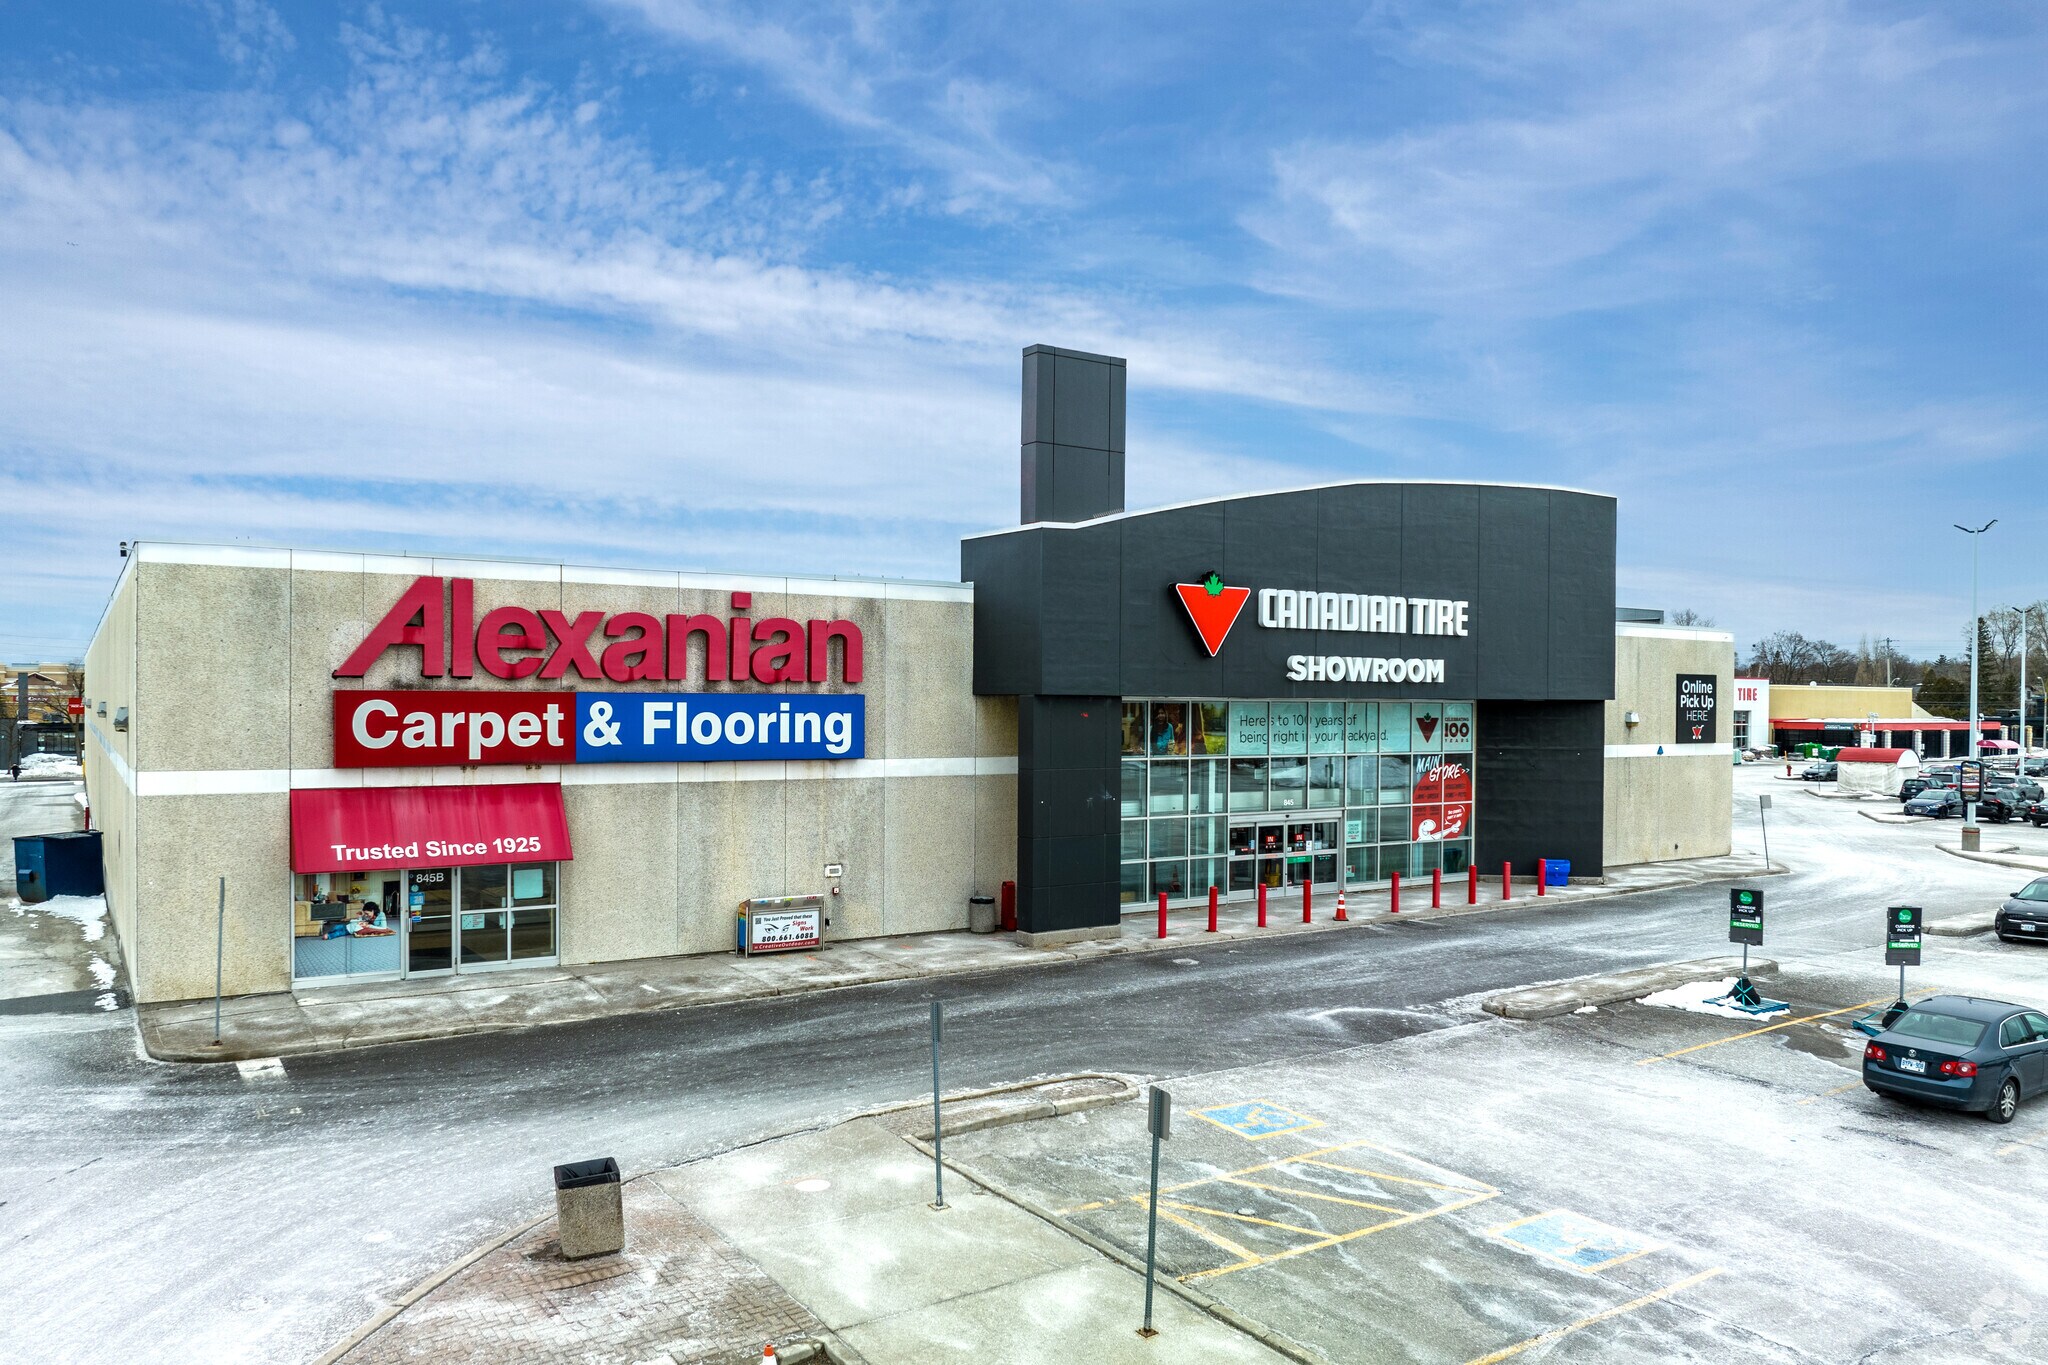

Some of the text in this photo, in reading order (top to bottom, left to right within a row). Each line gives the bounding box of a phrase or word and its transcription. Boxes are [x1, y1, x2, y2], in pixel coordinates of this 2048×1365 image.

[1258, 588, 1469, 637] CANADIAN TIRE
[332, 577, 863, 683] Alexanian
[1286, 655, 1445, 683] SHOWROOM
[1682, 680, 1713, 694] Online
[1738, 688, 1758, 701] TIRE
[1680, 695, 1714, 710] Pick Up
[1278, 715, 1289, 726] to
[1315, 716, 1343, 728] years
[1686, 710, 1708, 721] HERE
[352, 699, 852, 760] Carpet & Flooring
[1273, 730, 1298, 744] right
[1315, 732, 1338, 744] your
[1444, 722, 1470, 738] 100
[1416, 755, 1441, 774] MAIN
[1429, 763, 1462, 782] STORE
[331, 837, 541, 861] Trusted Since 1925
[416, 872, 444, 883] 845B
[1732, 921, 1760, 929] RESERVED
